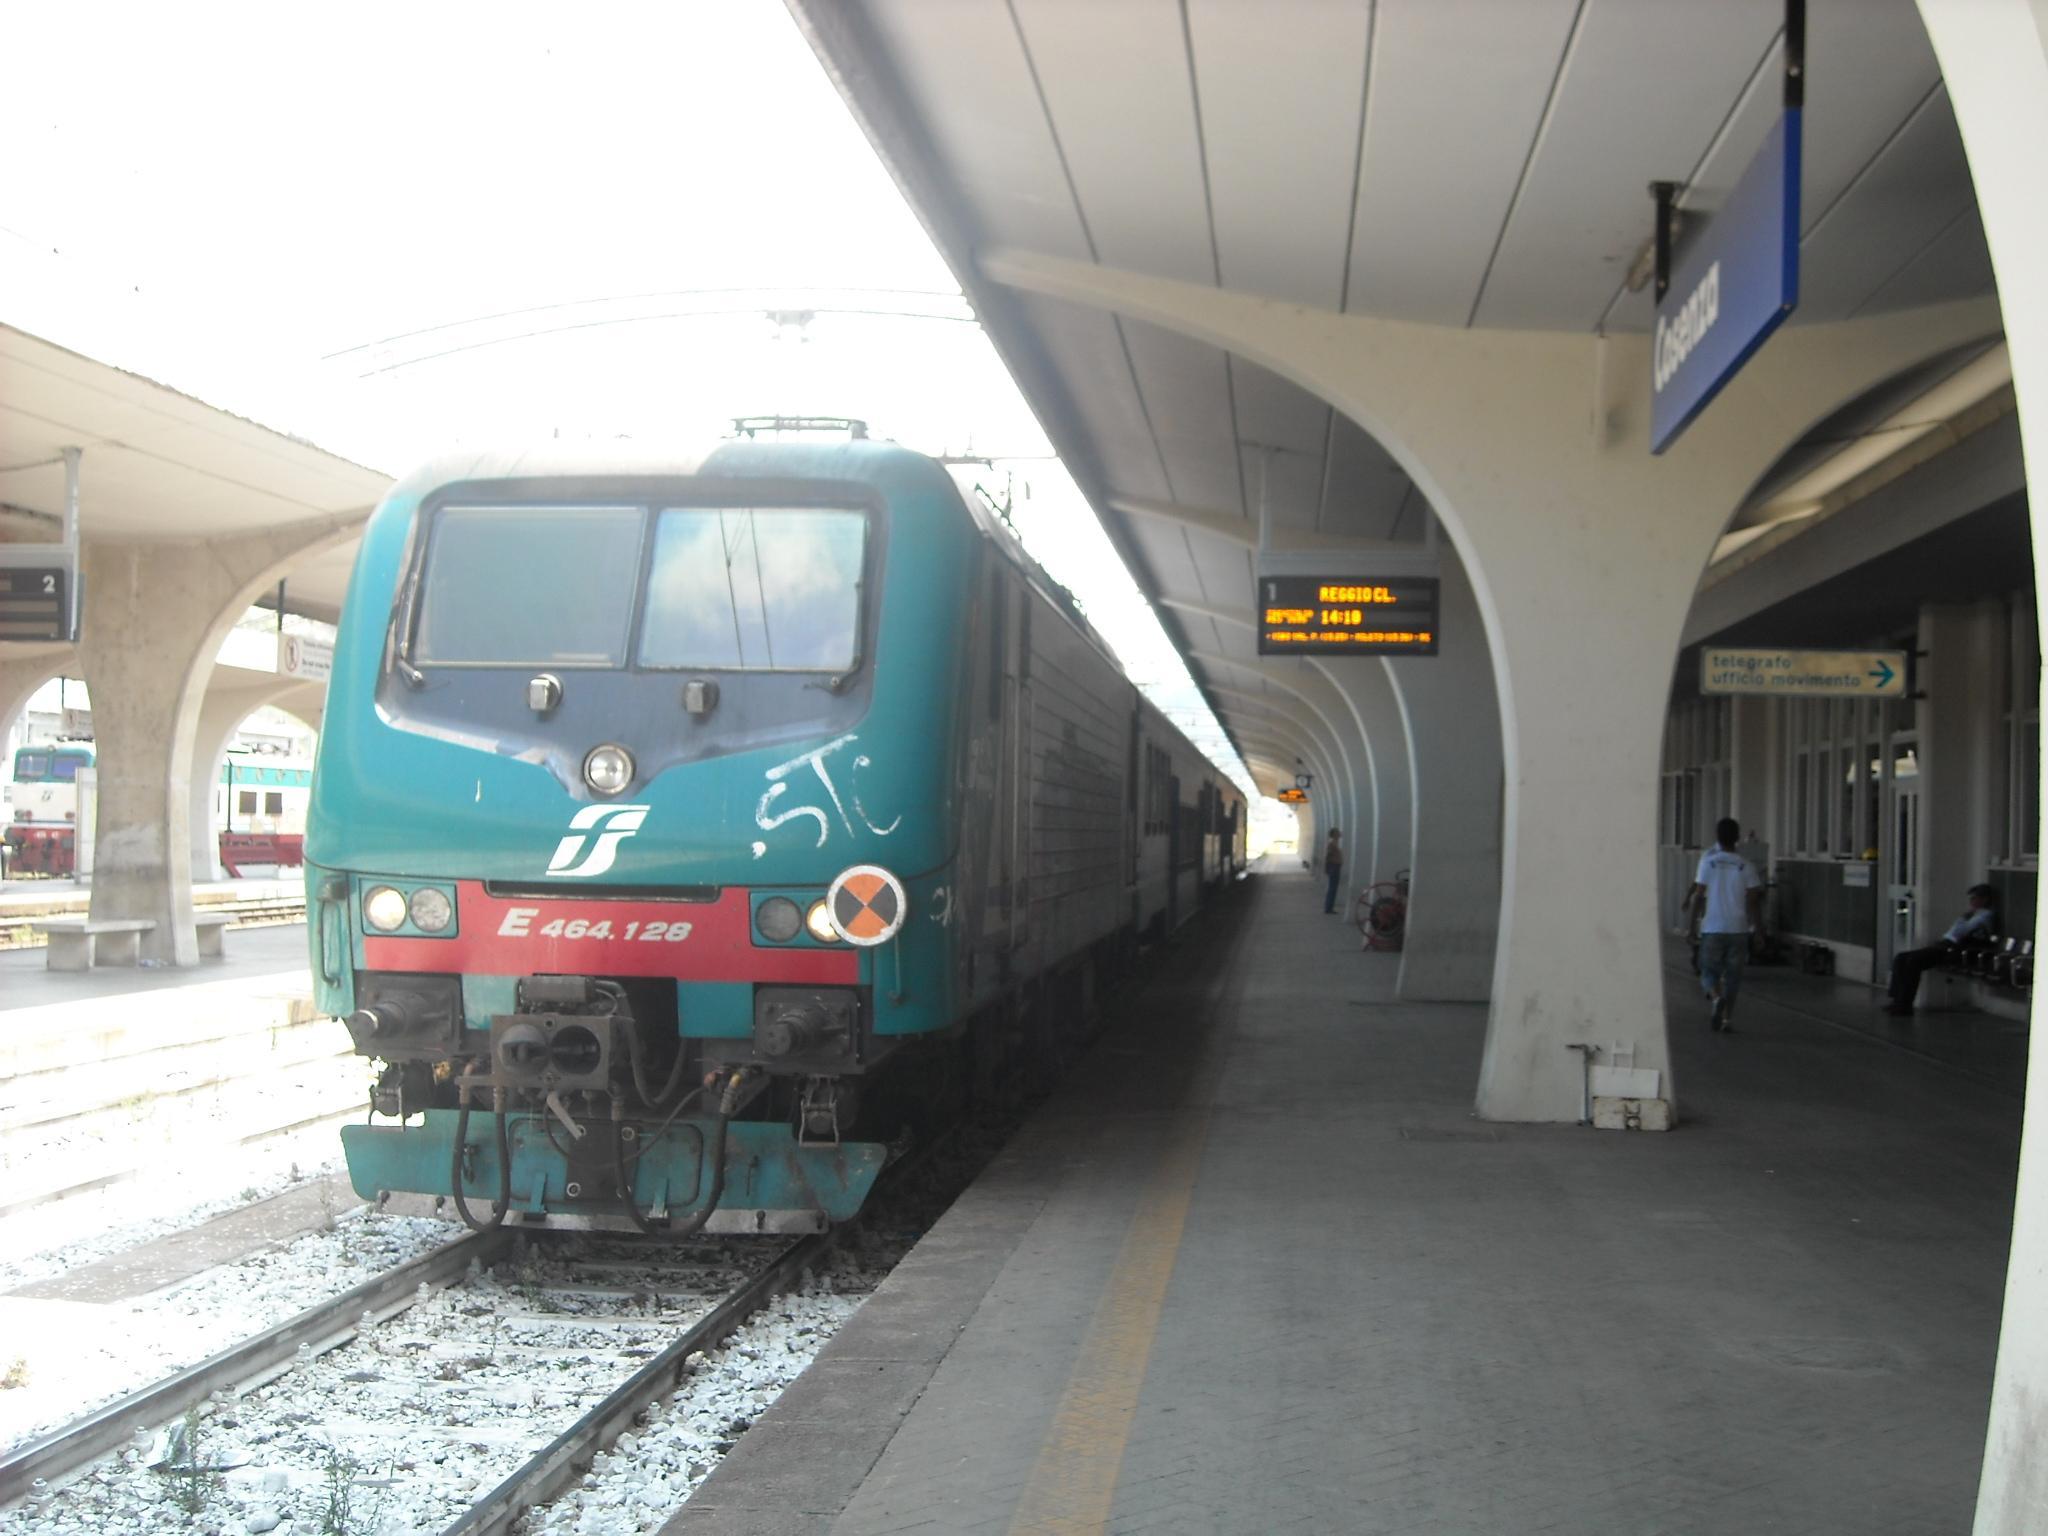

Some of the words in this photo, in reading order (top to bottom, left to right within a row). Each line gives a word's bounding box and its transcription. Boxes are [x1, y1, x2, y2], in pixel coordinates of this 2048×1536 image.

[1654, 260, 1720, 392] Cosenza
[42, 575, 56, 594] 2
[1319, 586, 1372, 603] REGGIO
[1712, 656, 1792, 670] telegrafo
[1712, 671, 1765, 686] ufficio
[1771, 675, 1861, 688] movimento
[497, 907, 540, 937] E
[540, 919, 692, 942] 464.128
